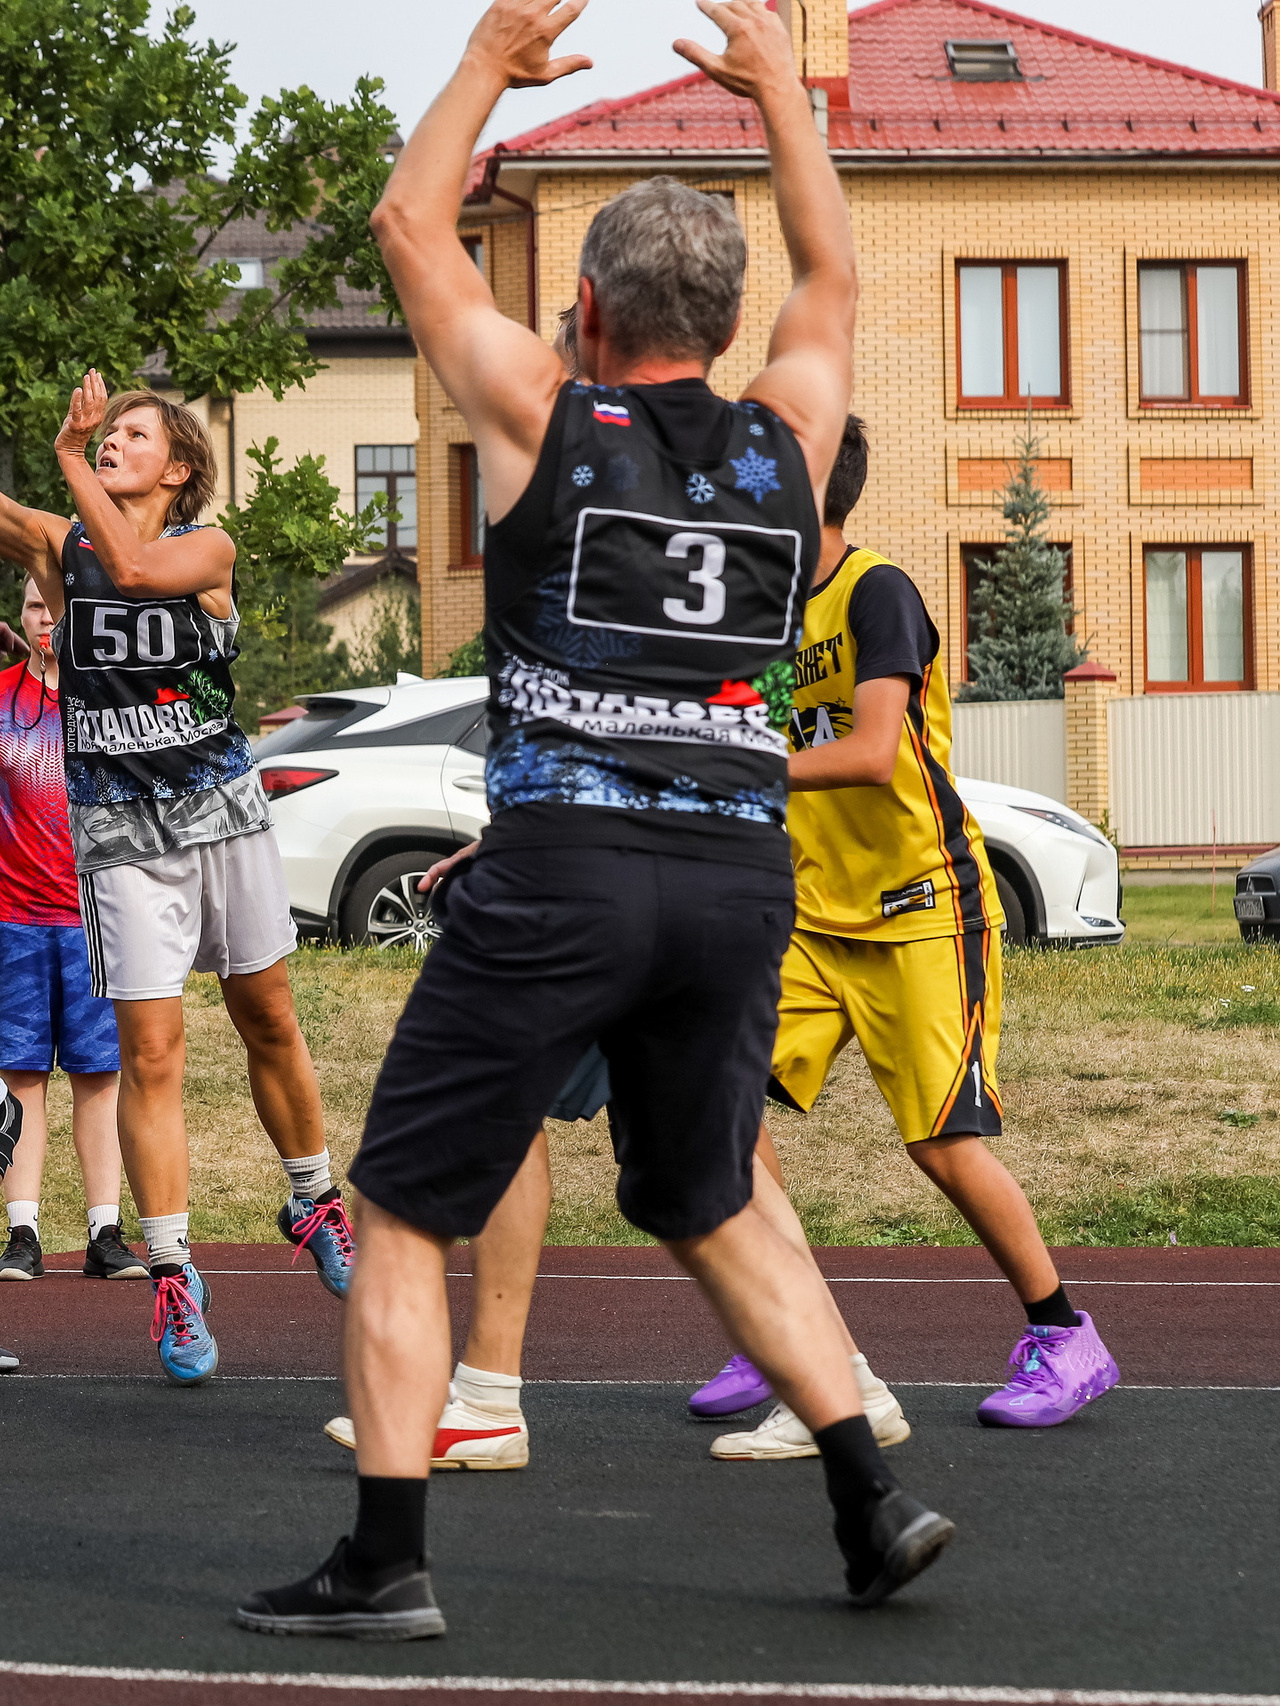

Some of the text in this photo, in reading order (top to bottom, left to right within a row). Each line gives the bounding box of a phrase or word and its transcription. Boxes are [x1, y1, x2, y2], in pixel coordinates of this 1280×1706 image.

[662, 531, 727, 626] 3
[92, 606, 176, 663] 50
[794, 631, 843, 691] SKET
[971, 1060, 982, 1108] 1
